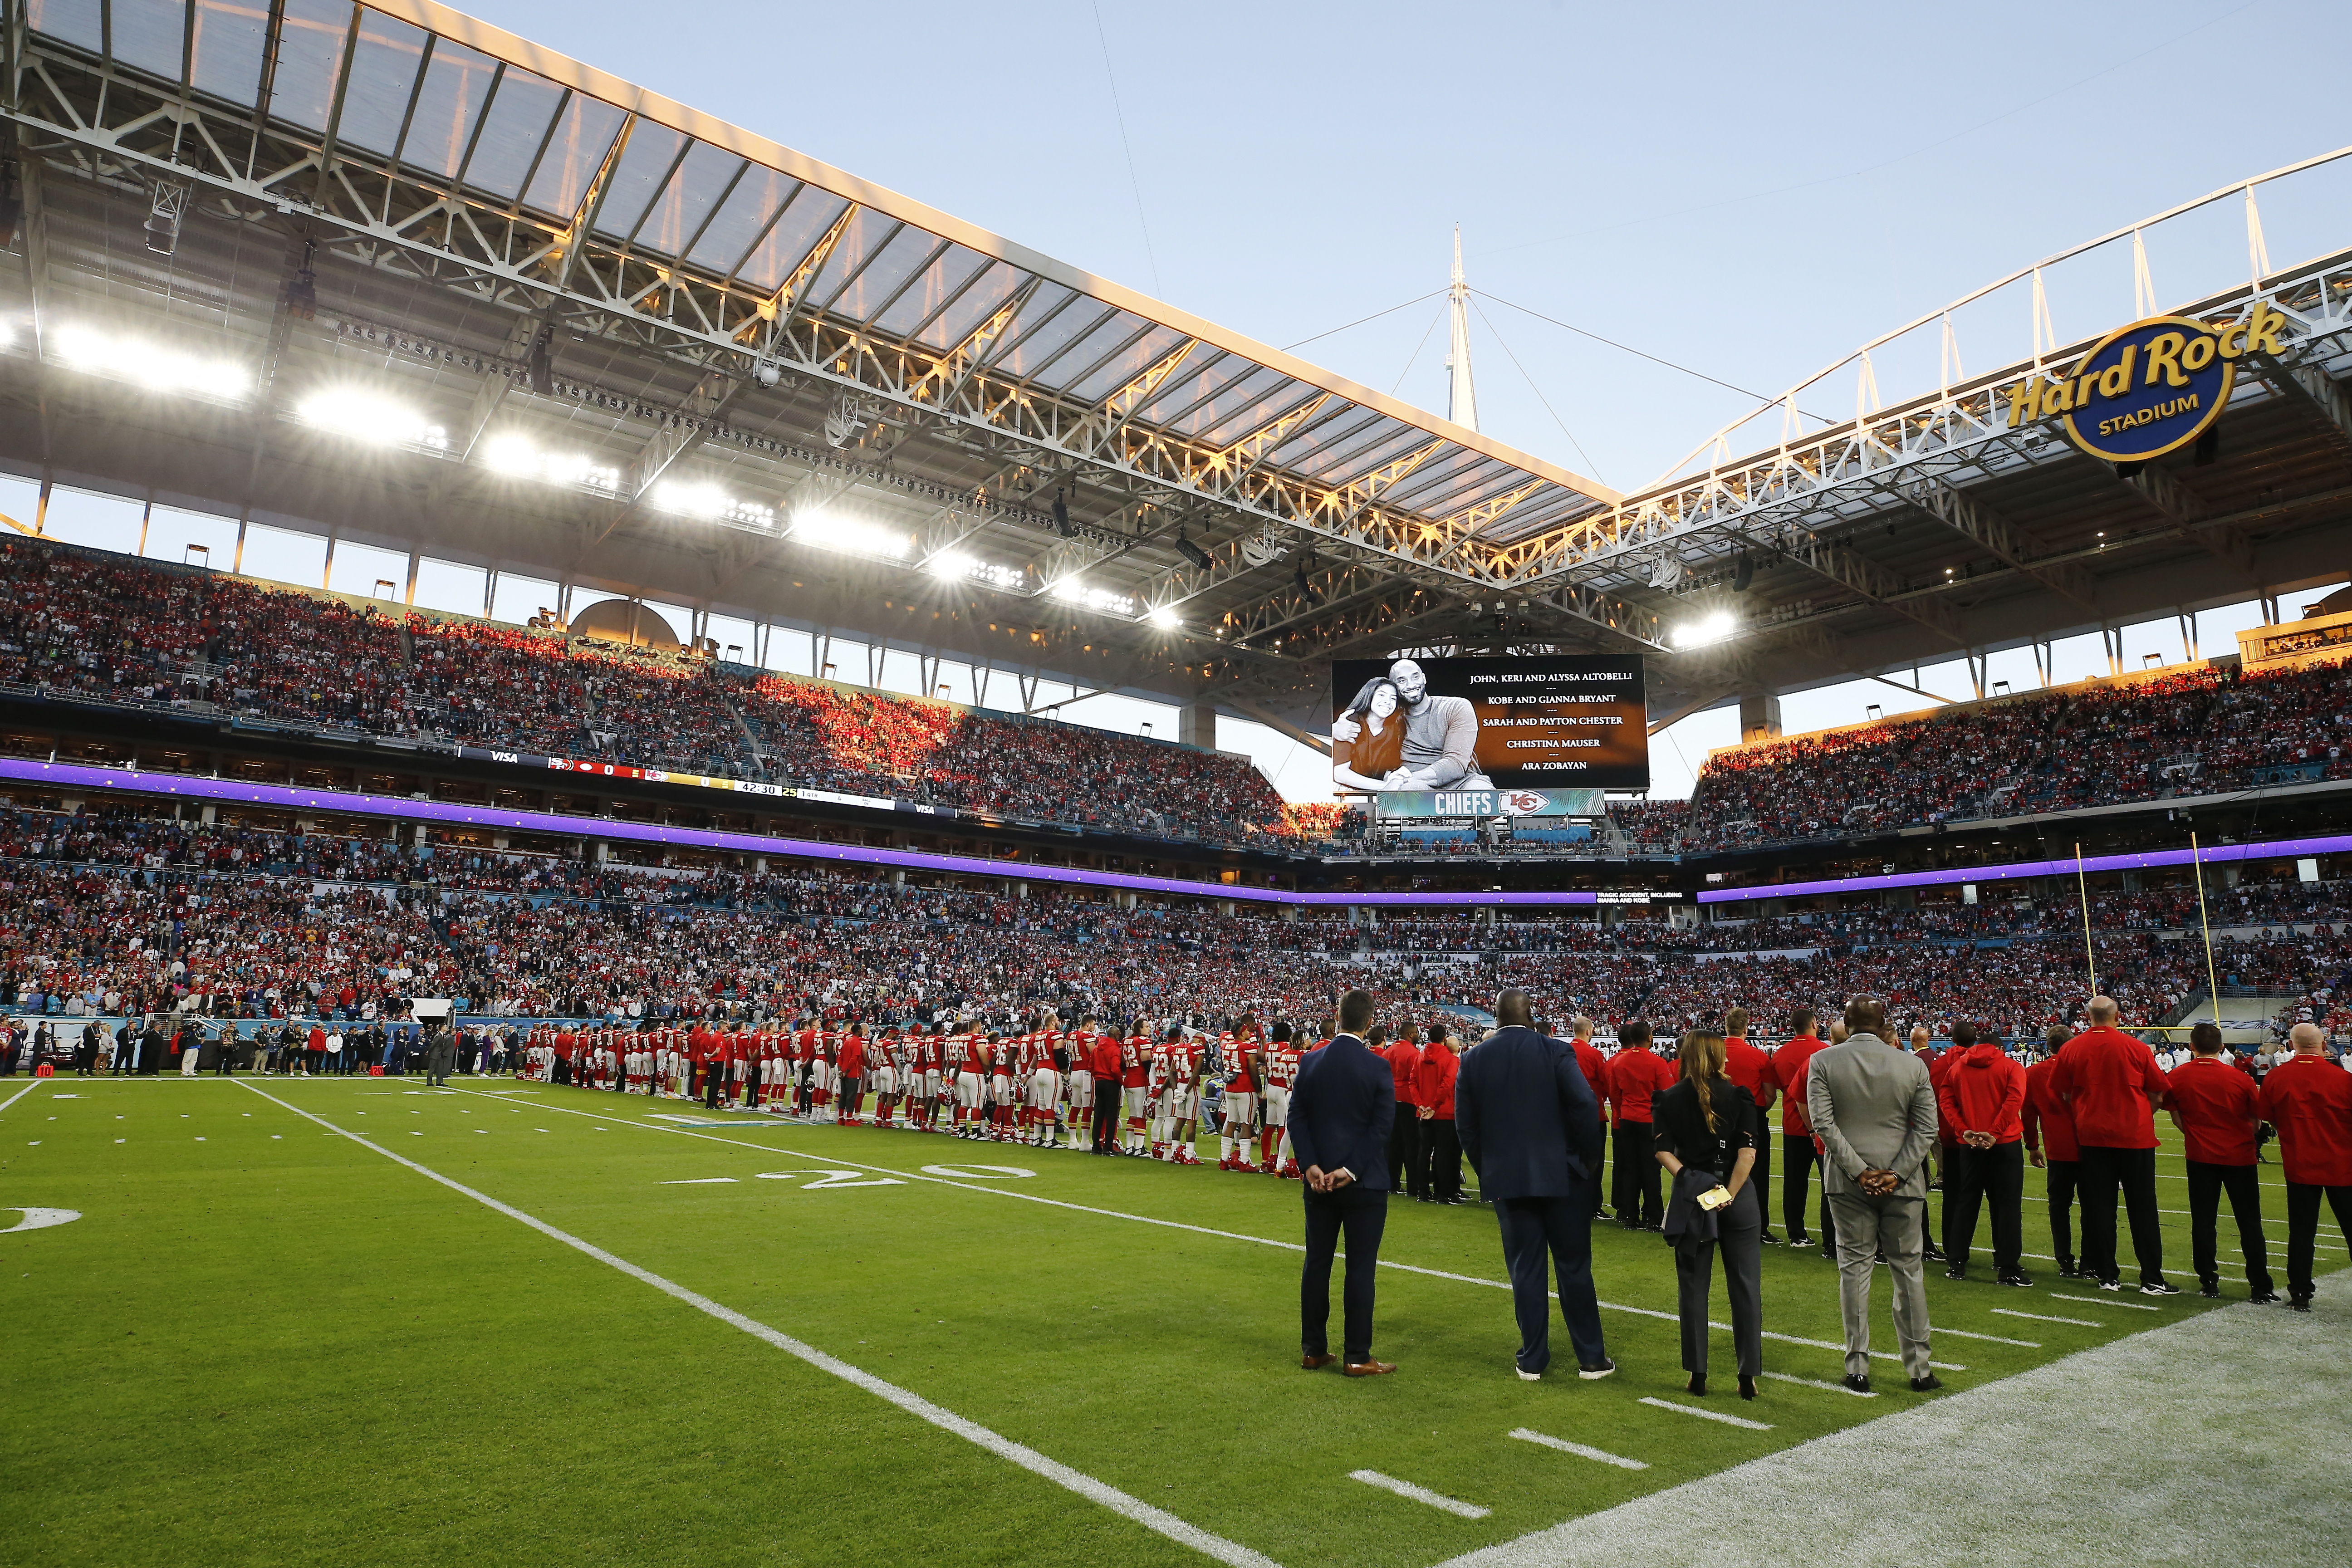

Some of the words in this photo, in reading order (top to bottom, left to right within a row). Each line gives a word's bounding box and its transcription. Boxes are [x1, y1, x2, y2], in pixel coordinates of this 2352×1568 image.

[2007, 344, 2137, 429] Hard
[2144, 300, 2288, 388] Rock
[2099, 393, 2199, 436] STADIUM
[1470, 675, 1499, 684] JOHN,
[1582, 672, 1632, 681] ALTOBELLI
[1579, 695, 1616, 703] BRYANT
[1483, 718, 1514, 726] SARAH
[1516, 718, 1537, 726] AND
[1539, 717, 1577, 725] PAYTON
[1579, 716, 1623, 725] CHESTER
[1506, 740, 1559, 749] CHRISTINA
[1561, 739, 1601, 748] MAUSER
[490, 750, 518, 763] VISA
[1543, 762, 1587, 770] ZOBAYAN
[604, 764, 614, 775] 0
[742, 783, 775, 794] 42:30
[782, 787, 797, 797] 25
[1435, 792, 1492, 814] CHIEFS
[914, 804, 935, 815] VISA
[41, 1067, 51, 1077] 10
[374, 1067, 383, 1075] 20
